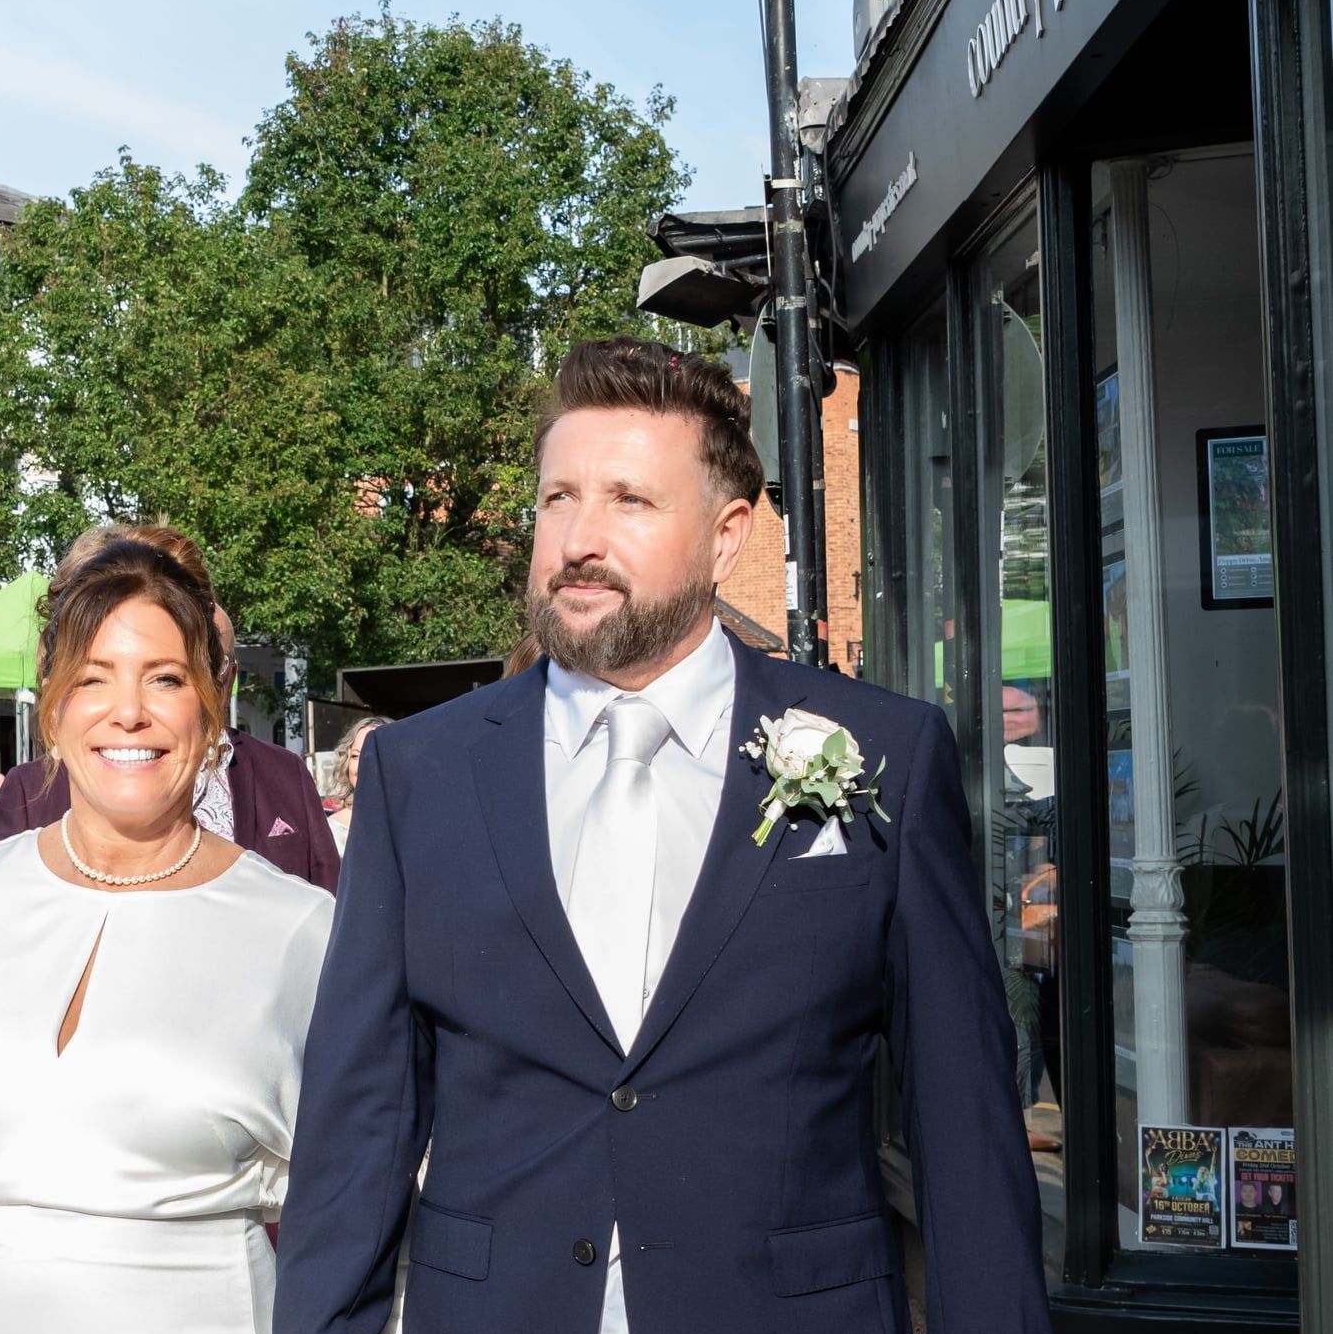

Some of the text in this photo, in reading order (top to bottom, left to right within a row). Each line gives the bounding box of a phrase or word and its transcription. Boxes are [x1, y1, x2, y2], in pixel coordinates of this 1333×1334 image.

[1216, 444, 1261, 455] FOR SALE
[1151, 1130, 1211, 1152] ABBA
[1255, 1140, 1282, 1149] ANT
[1171, 1201, 1210, 1214] OCTOBER
